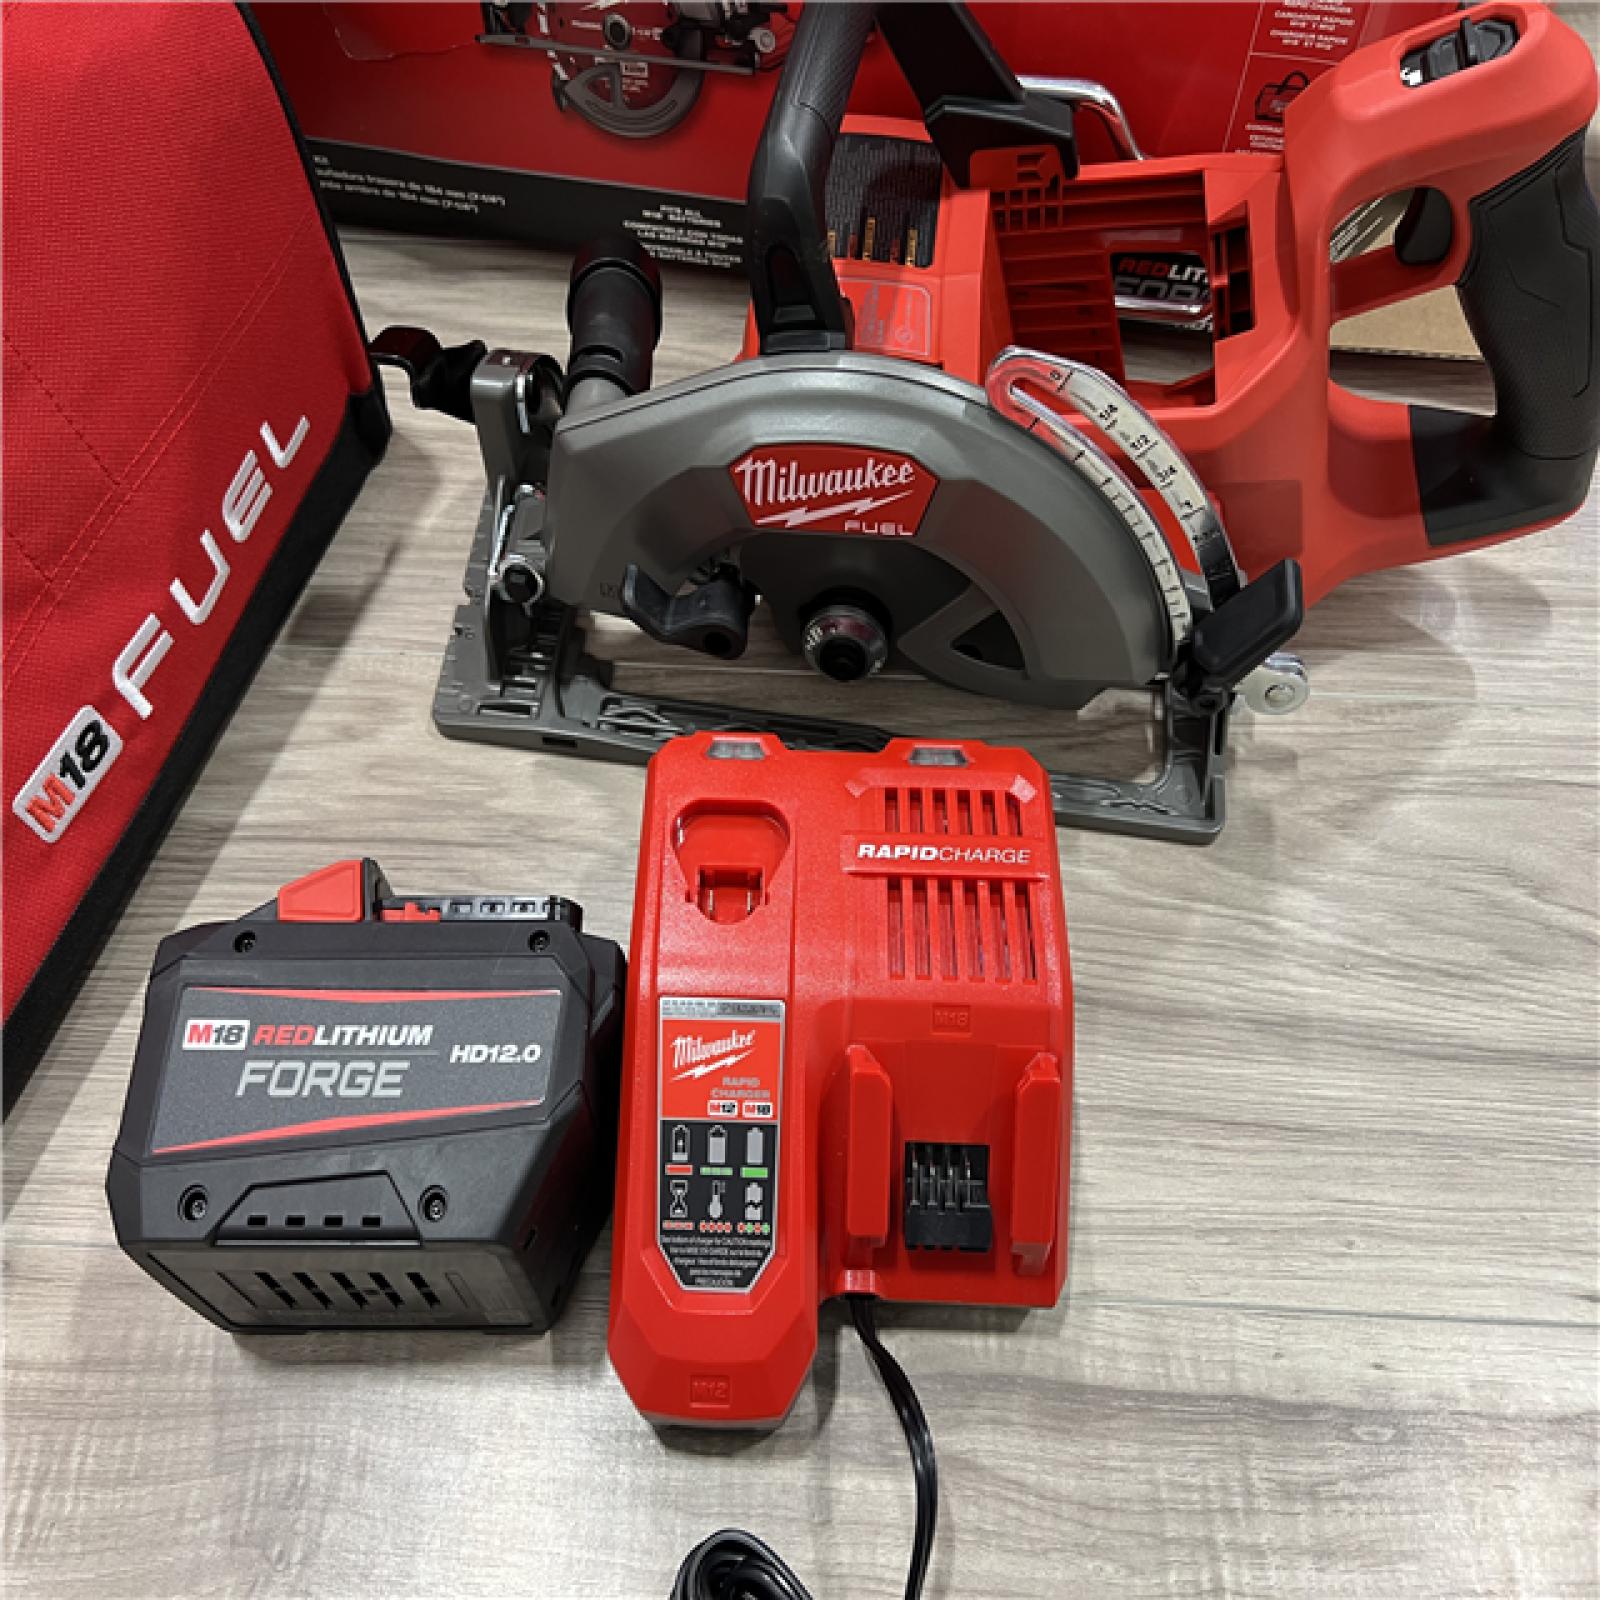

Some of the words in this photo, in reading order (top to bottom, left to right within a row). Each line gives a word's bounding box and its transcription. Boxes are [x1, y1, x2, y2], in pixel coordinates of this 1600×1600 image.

[1118, 259, 1209, 284] REDLIT
[734, 454, 916, 506] Milwaukee
[844, 519, 914, 536] FUEL
[27, 719, 110, 834] M18
[112, 415, 310, 720] FUEL
[856, 843, 1032, 864] RAPIDCHARGE
[184, 1022, 247, 1047] M18
[252, 1023, 434, 1046] REDLITHIUM
[449, 1043, 542, 1064] HD12.0
[670, 1029, 756, 1070] Milwaukee
[235, 1059, 411, 1098] FORGE
